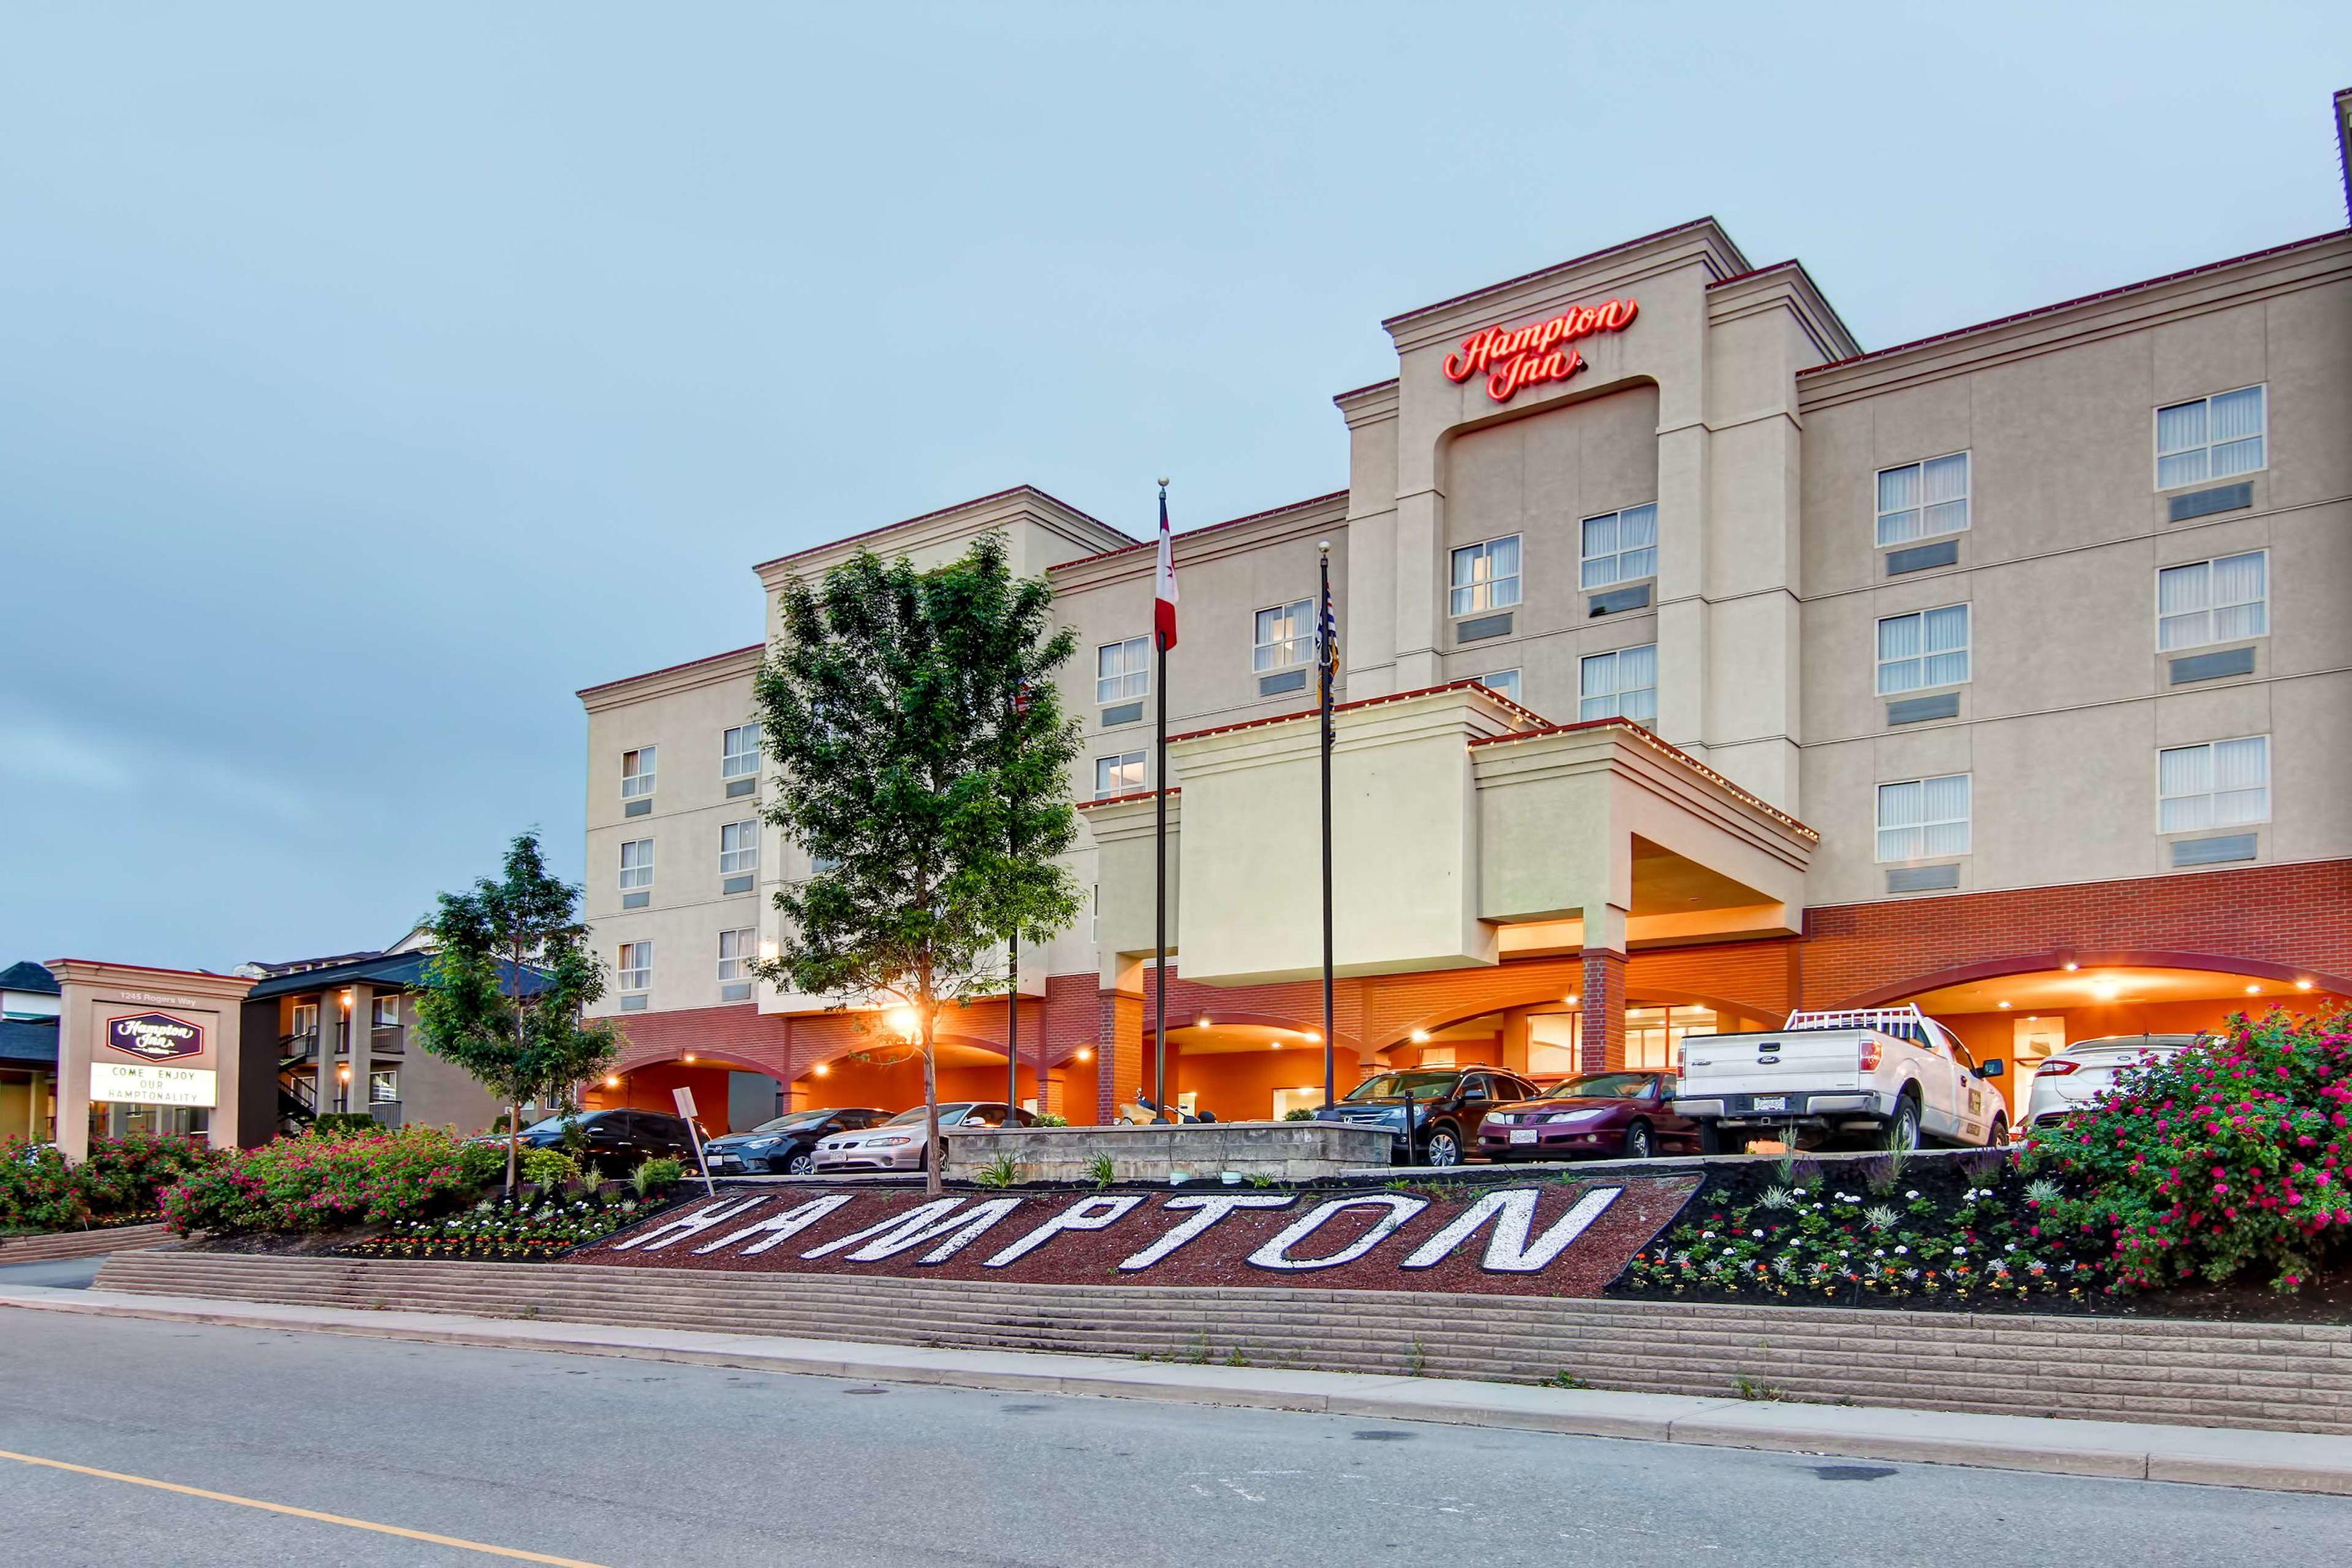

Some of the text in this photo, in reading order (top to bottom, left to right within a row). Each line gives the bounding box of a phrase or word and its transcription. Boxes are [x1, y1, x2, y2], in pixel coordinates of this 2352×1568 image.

[1442, 297, 1639, 384] Hampton
[1486, 348, 1587, 404] Inn
[121, 992, 196, 1007] 1245 Rogers Way
[118, 1020, 194, 1039] Hampton
[136, 1033, 175, 1048] Inn
[112, 1067, 195, 1080] COME ENJOY
[140, 1079, 163, 1090] OUR
[108, 1089, 197, 1103] HAMPTONALITY
[611, 1184, 1627, 1273] HAMPTON
